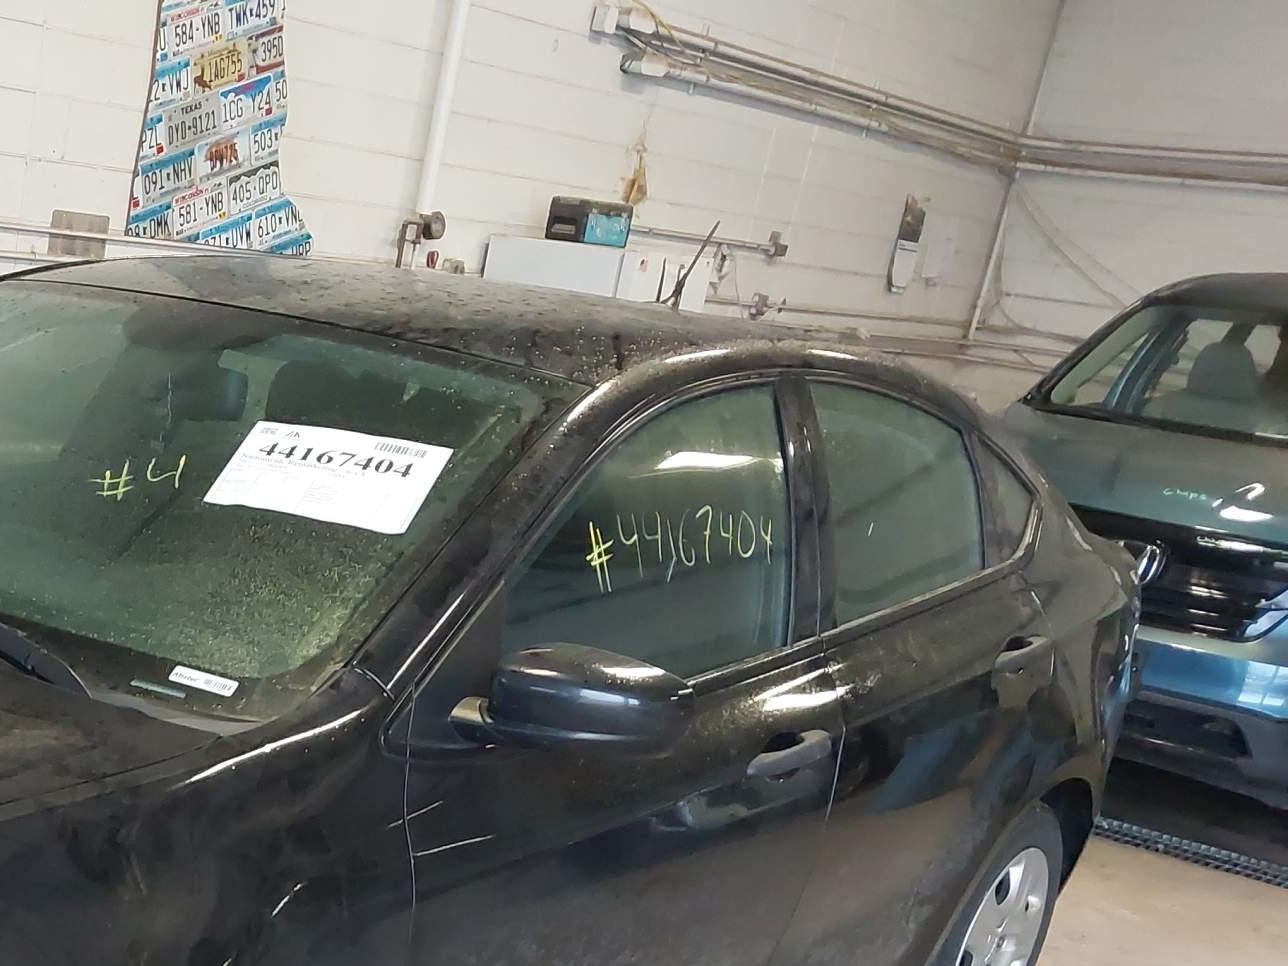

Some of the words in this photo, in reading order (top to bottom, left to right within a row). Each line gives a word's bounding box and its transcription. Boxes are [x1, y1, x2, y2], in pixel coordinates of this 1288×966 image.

[175, 12, 221, 48] 584-YNB
[208, 53, 243, 83] 1AG755
[181, 101, 203, 116] TEXAS
[179, 192, 224, 227] 581-YNB
[258, 441, 414, 478] 44167404
